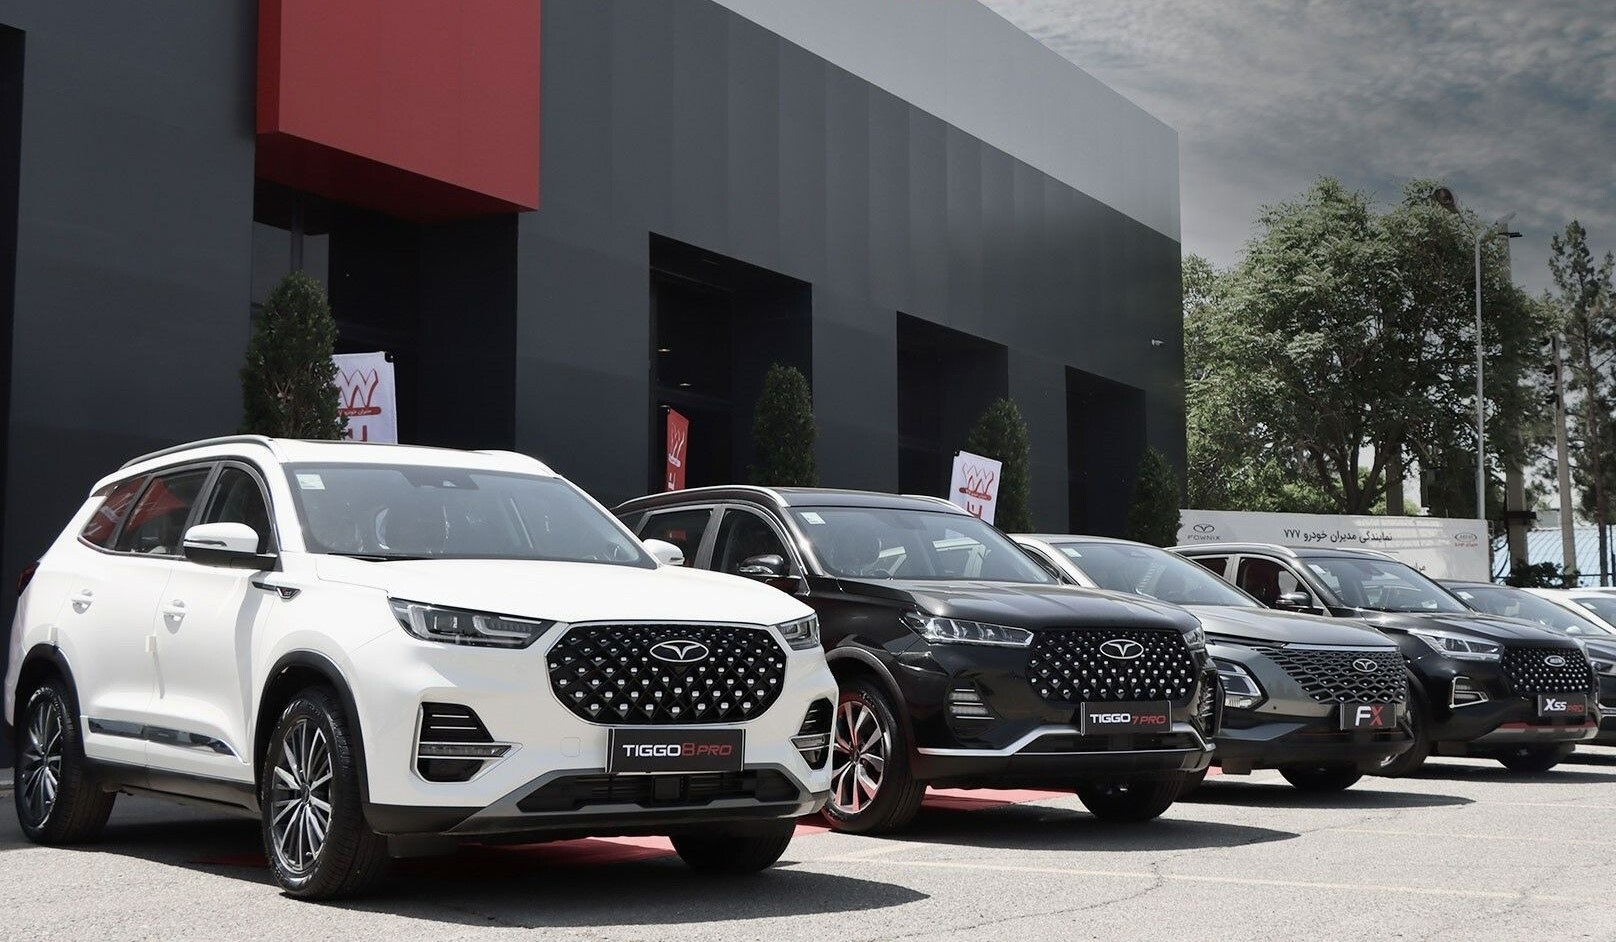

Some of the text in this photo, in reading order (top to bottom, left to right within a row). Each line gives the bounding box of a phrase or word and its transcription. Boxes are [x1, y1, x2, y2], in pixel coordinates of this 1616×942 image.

[1303, 530, 1328, 542] خودرو
[1330, 531, 1357, 543] مدیران
[1359, 531, 1393, 543] نمایندگی
[1355, 705, 1384, 727] FX
[696, 744, 733, 756] PRO
